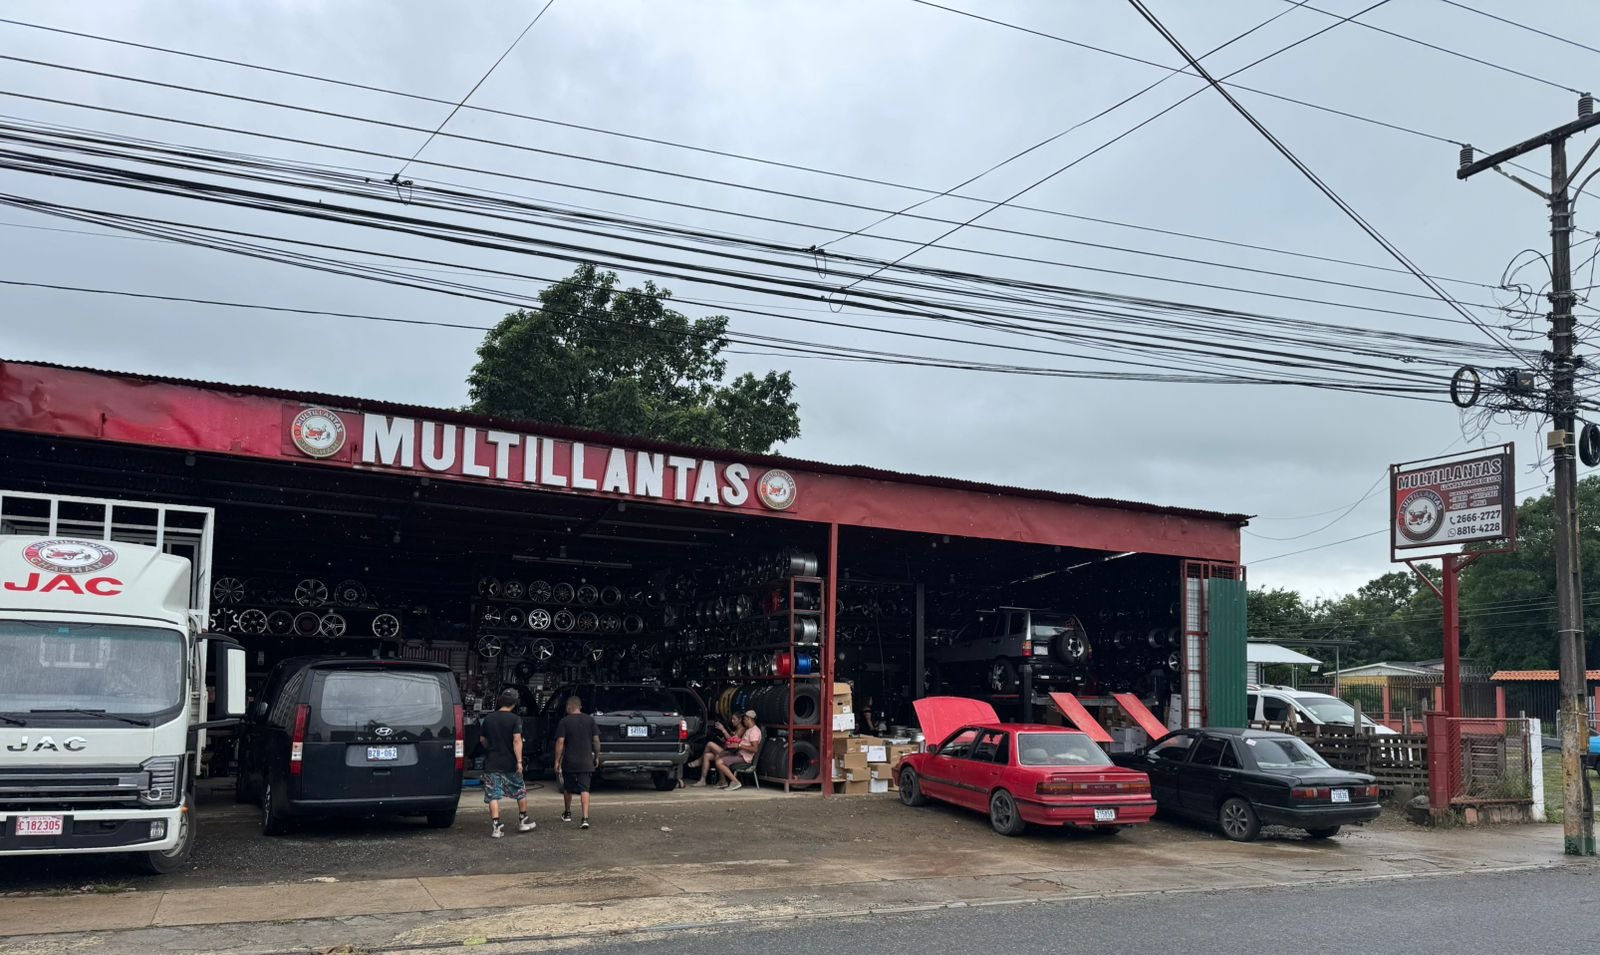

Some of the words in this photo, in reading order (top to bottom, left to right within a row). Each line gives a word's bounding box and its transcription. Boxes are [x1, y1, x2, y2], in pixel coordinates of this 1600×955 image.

[296, 409, 342, 433] MULTILLANTAS
[362, 413, 749, 506] MULTILLANTAS
[1397, 458, 1502, 490] MULTILLANTAS
[1456, 510, 1501, 524] 2666-2727
[1456, 523, 1500, 536] 8816-4228
[4, 572, 124, 596] JAC
[6, 735, 87, 752] JAC
[19, 820, 60, 831] C182305
